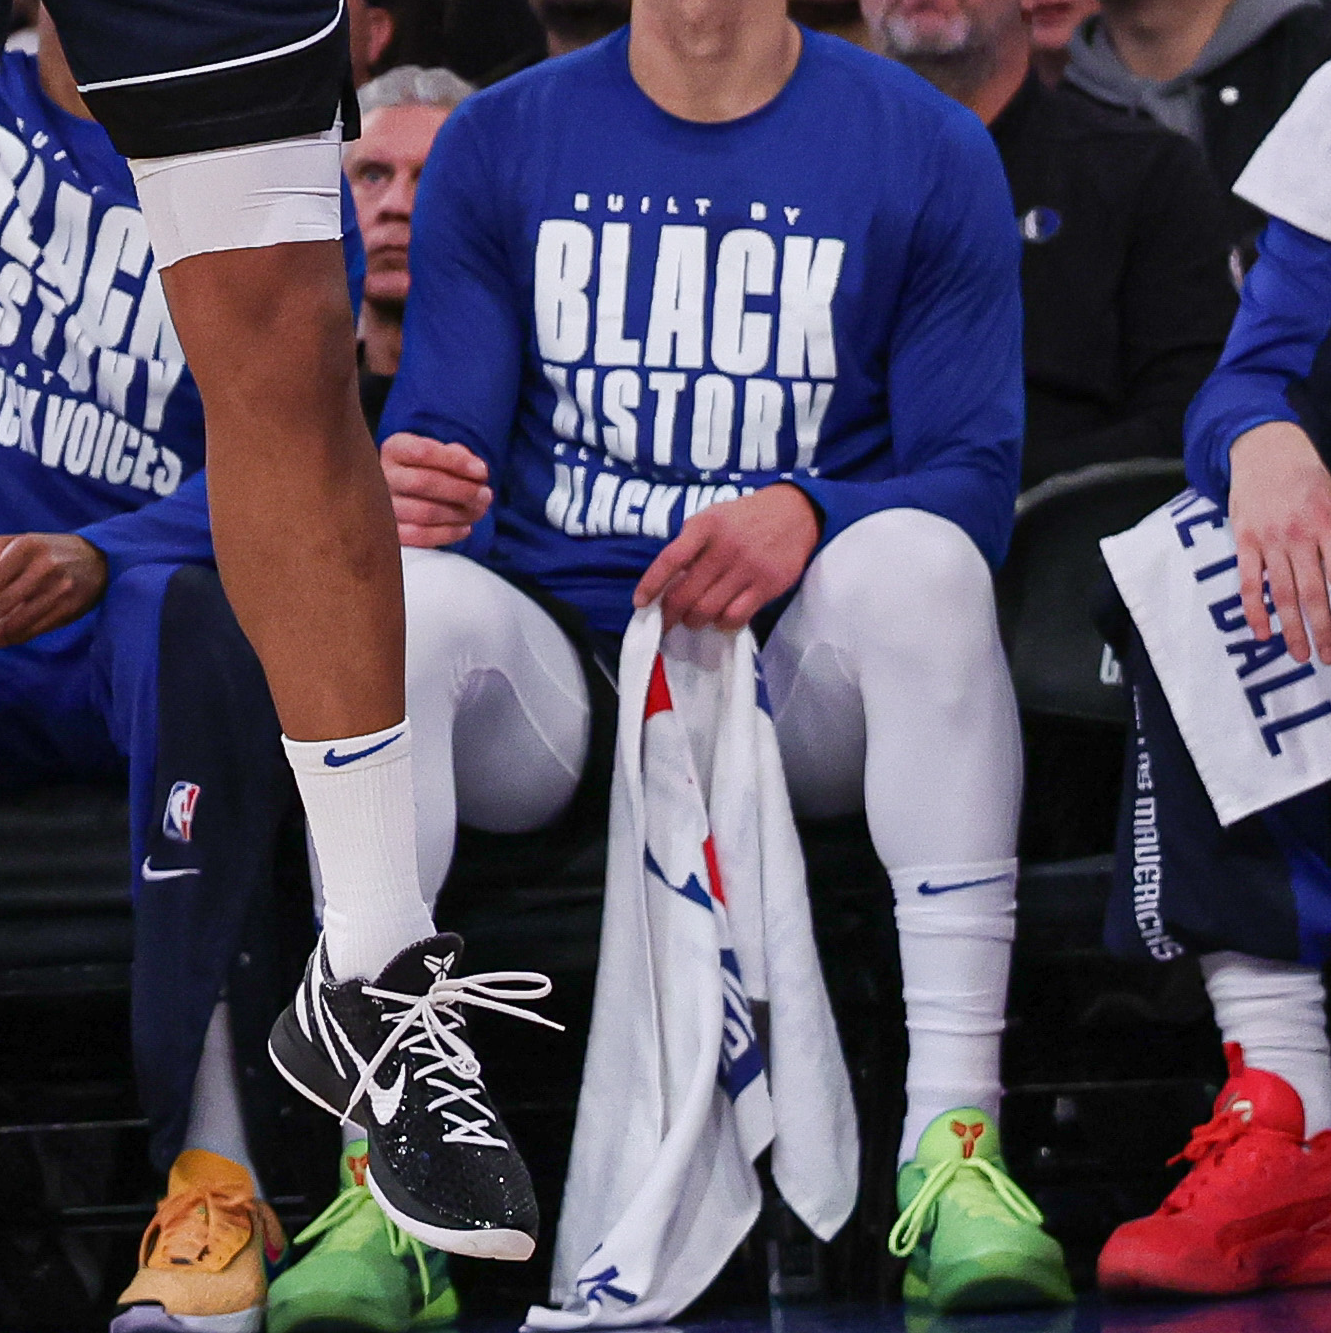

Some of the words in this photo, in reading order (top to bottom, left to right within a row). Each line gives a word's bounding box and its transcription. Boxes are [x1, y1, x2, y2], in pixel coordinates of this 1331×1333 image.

[574, 192, 712, 217] BUILT
[750, 202, 802, 226] BY
[534, 219, 846, 380] BLACK
